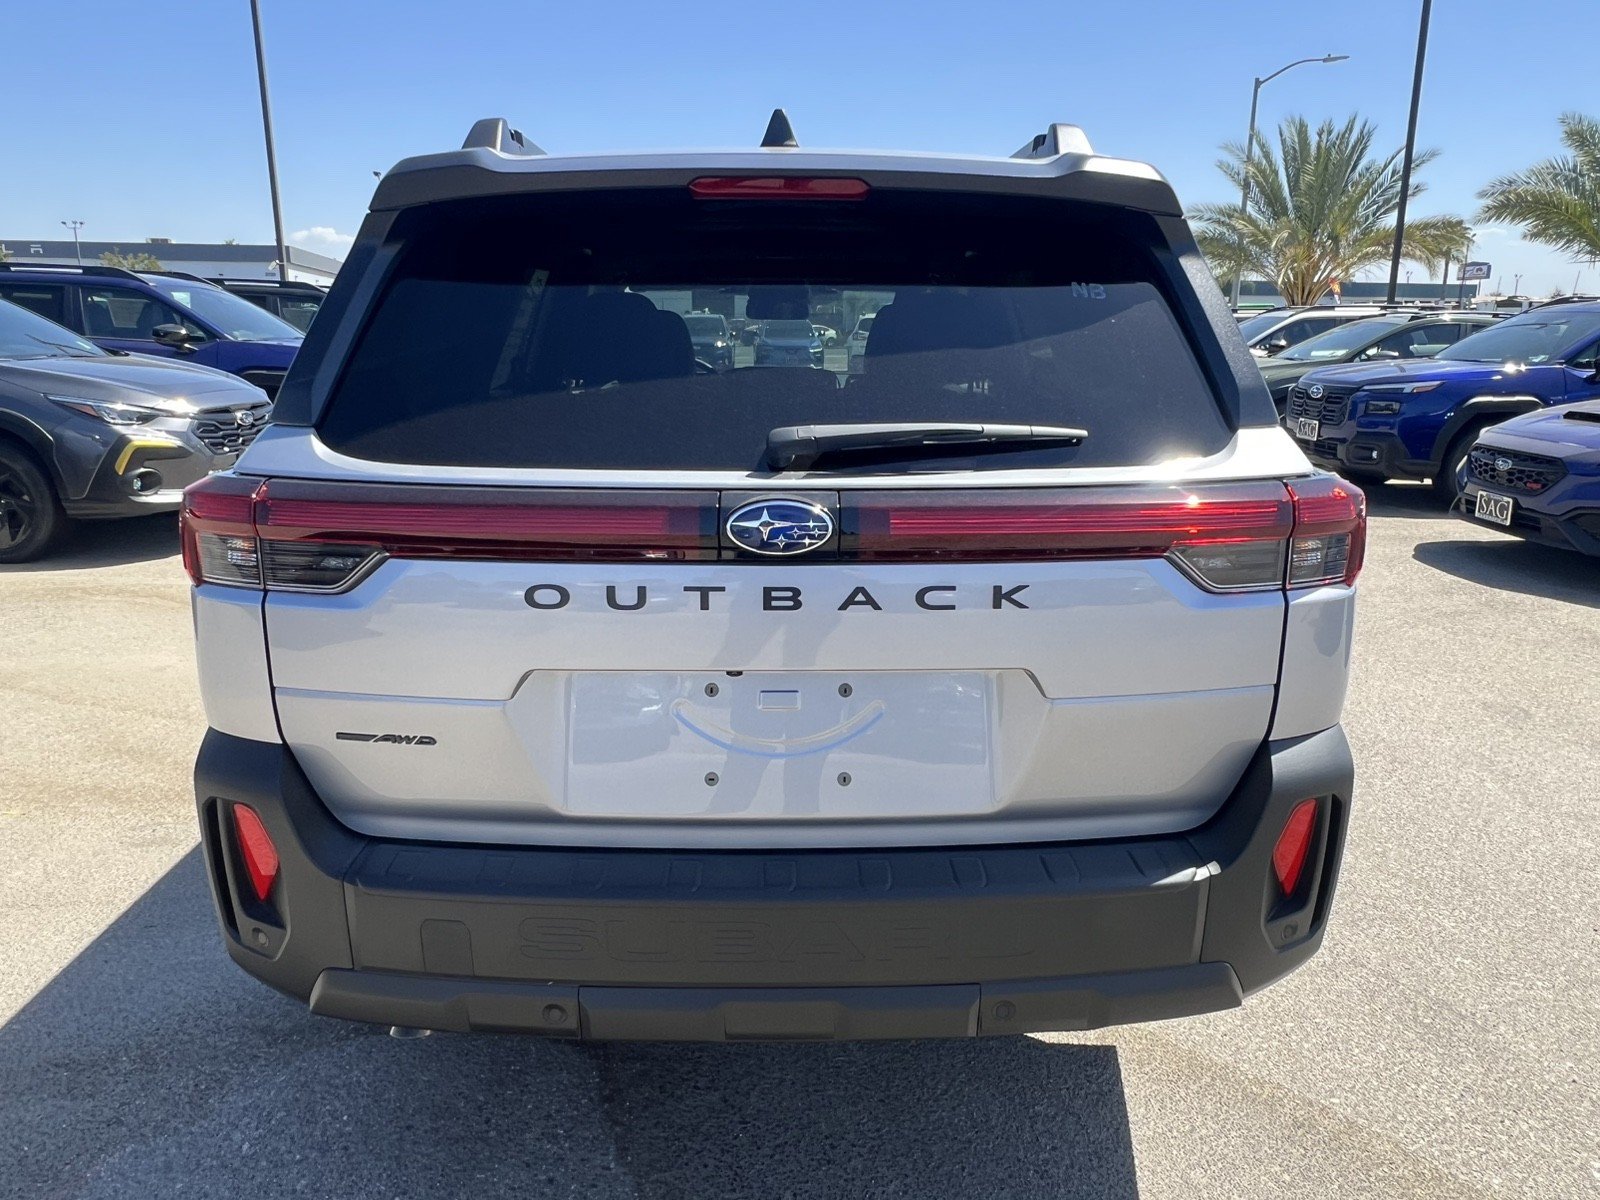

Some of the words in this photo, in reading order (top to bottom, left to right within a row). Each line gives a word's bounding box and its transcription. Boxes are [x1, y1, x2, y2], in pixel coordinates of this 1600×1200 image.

[1071, 281, 1106, 299] NB
[1479, 496, 1508, 519] SAG
[523, 583, 1031, 611] OUTBACK
[372, 733, 438, 746] AWD
[518, 916, 1036, 963] SUBAR
